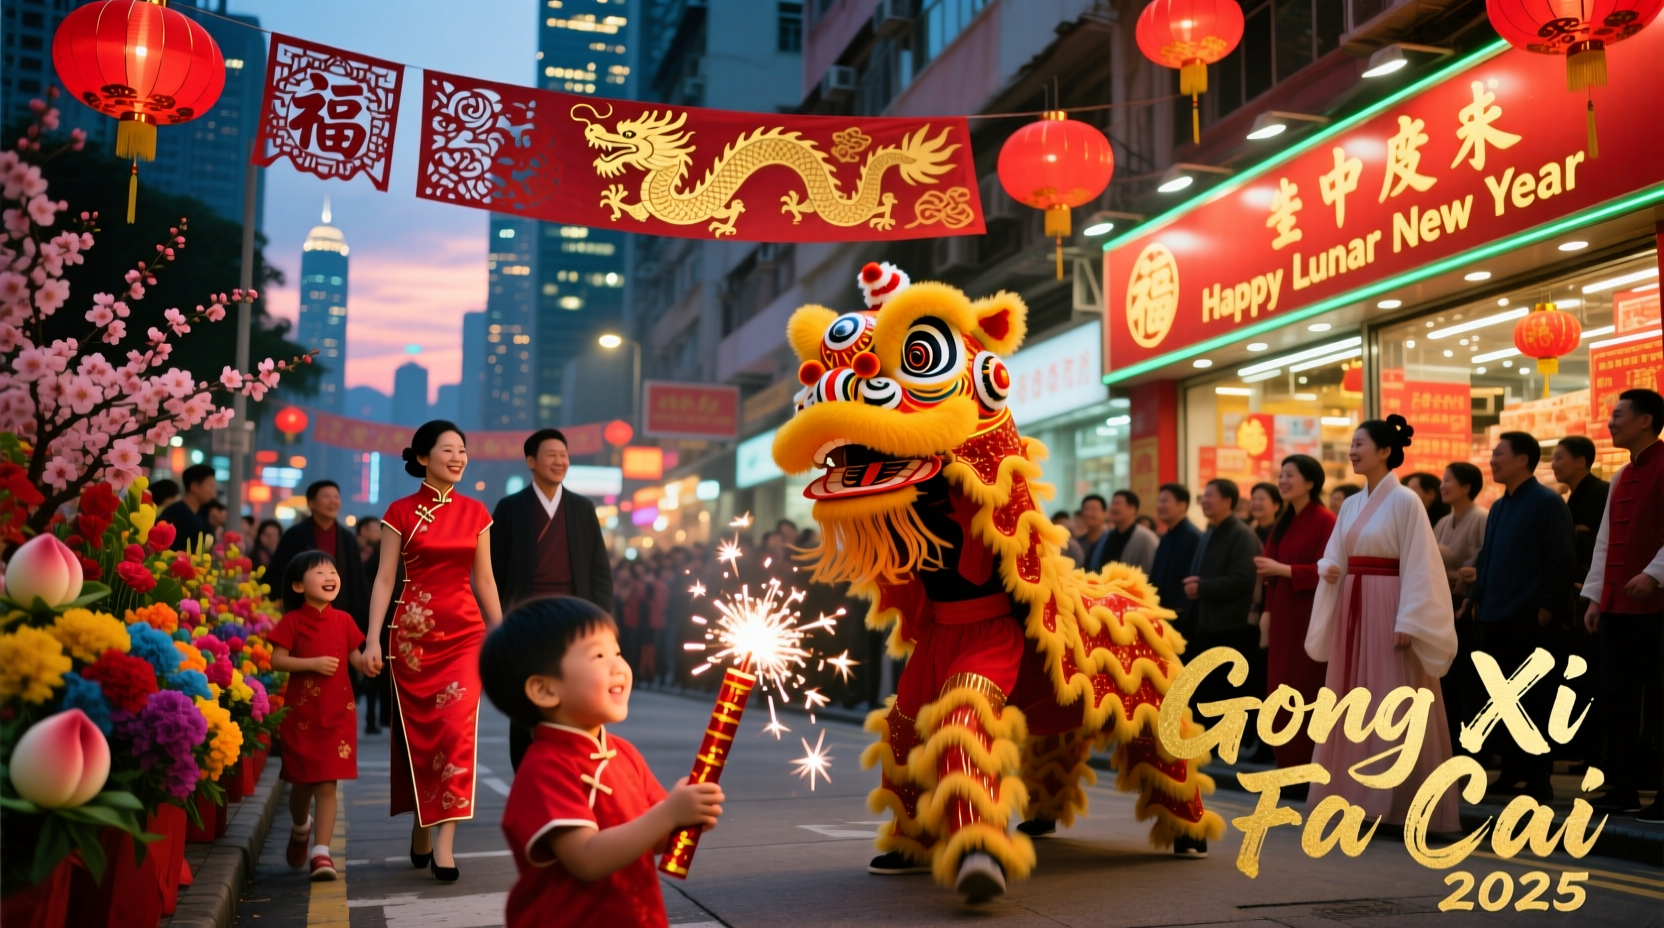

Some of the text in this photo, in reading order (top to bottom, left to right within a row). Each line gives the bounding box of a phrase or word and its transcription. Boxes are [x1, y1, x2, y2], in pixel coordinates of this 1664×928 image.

[289, 73, 366, 159] 福
[1202, 151, 1584, 323] Happy Lunar New Year
[1131, 253, 1174, 337] 福
